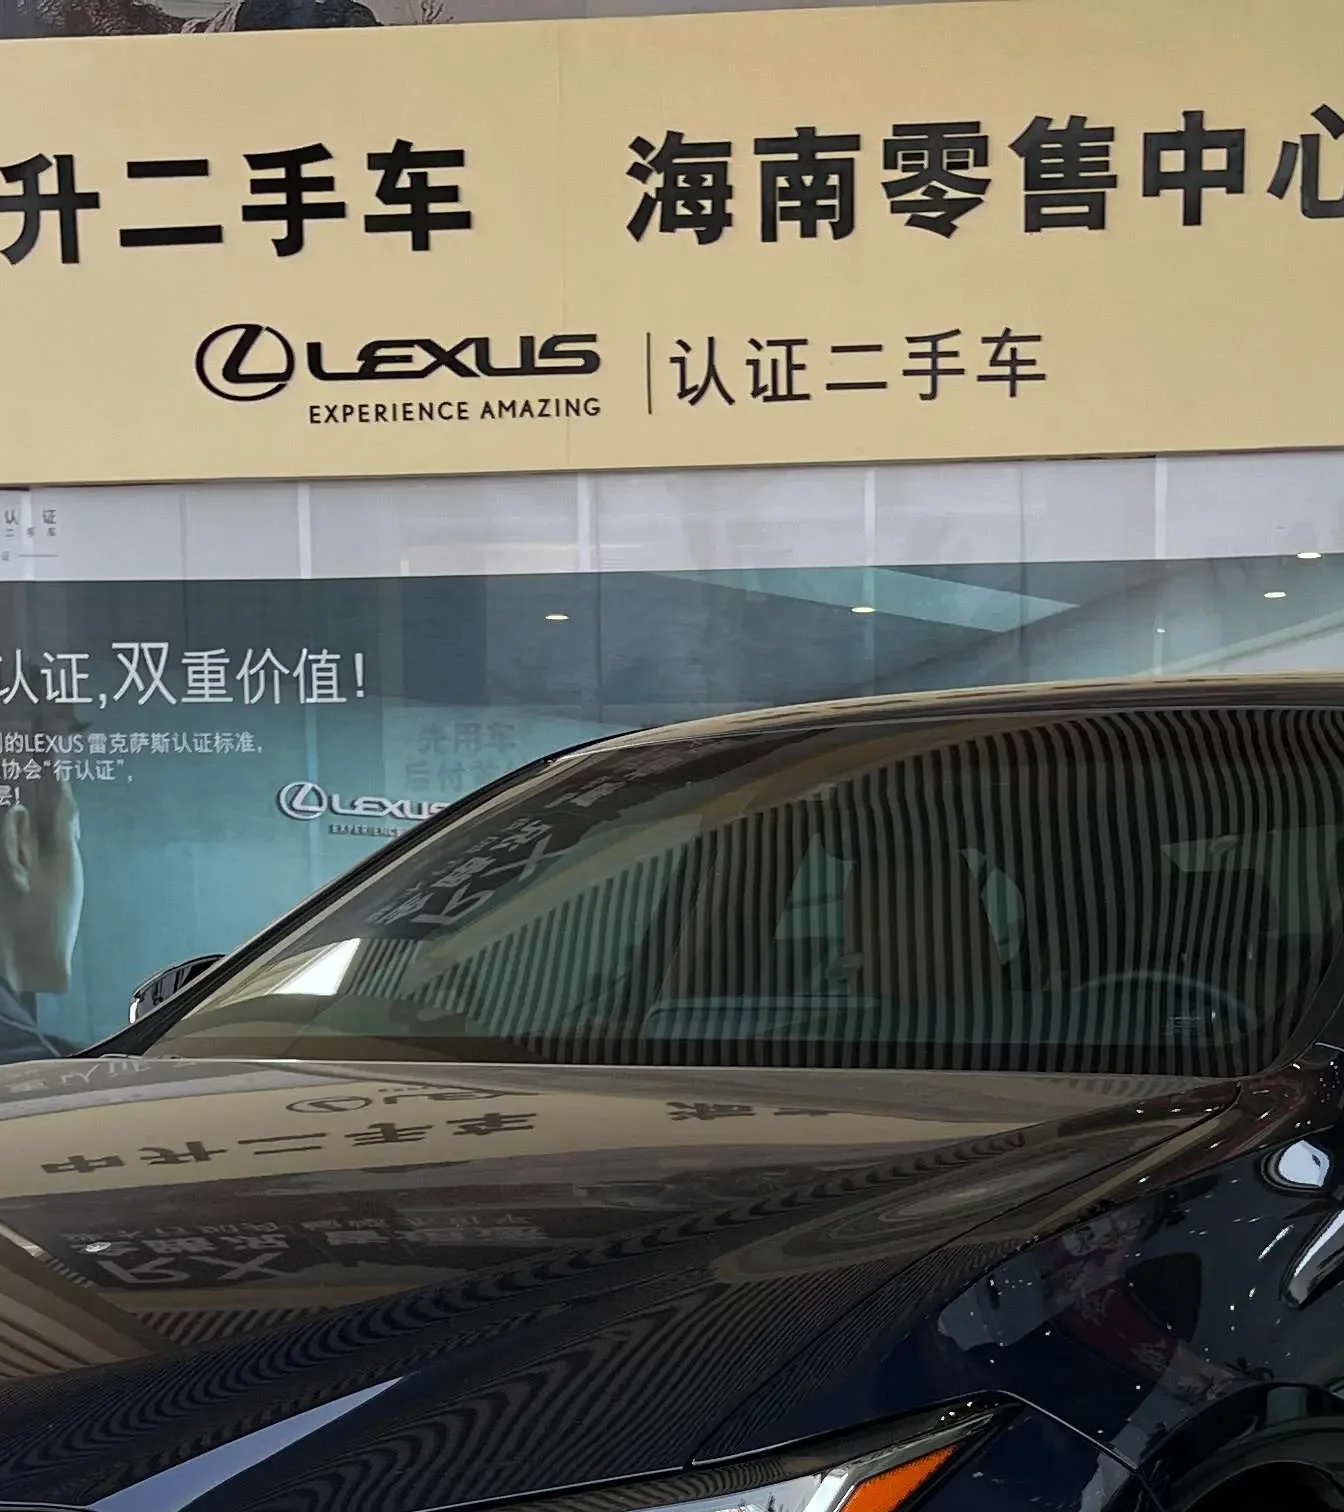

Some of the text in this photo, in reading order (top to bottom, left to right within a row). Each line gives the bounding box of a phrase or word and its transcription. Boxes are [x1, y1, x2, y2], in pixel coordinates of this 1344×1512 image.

[307, 333, 602, 383] LEXUS
[669, 329, 1048, 407] 认证二手车
[308, 398, 602, 425] EXPERIENCE AMAZING
[5, 509, 57, 526] 认证
